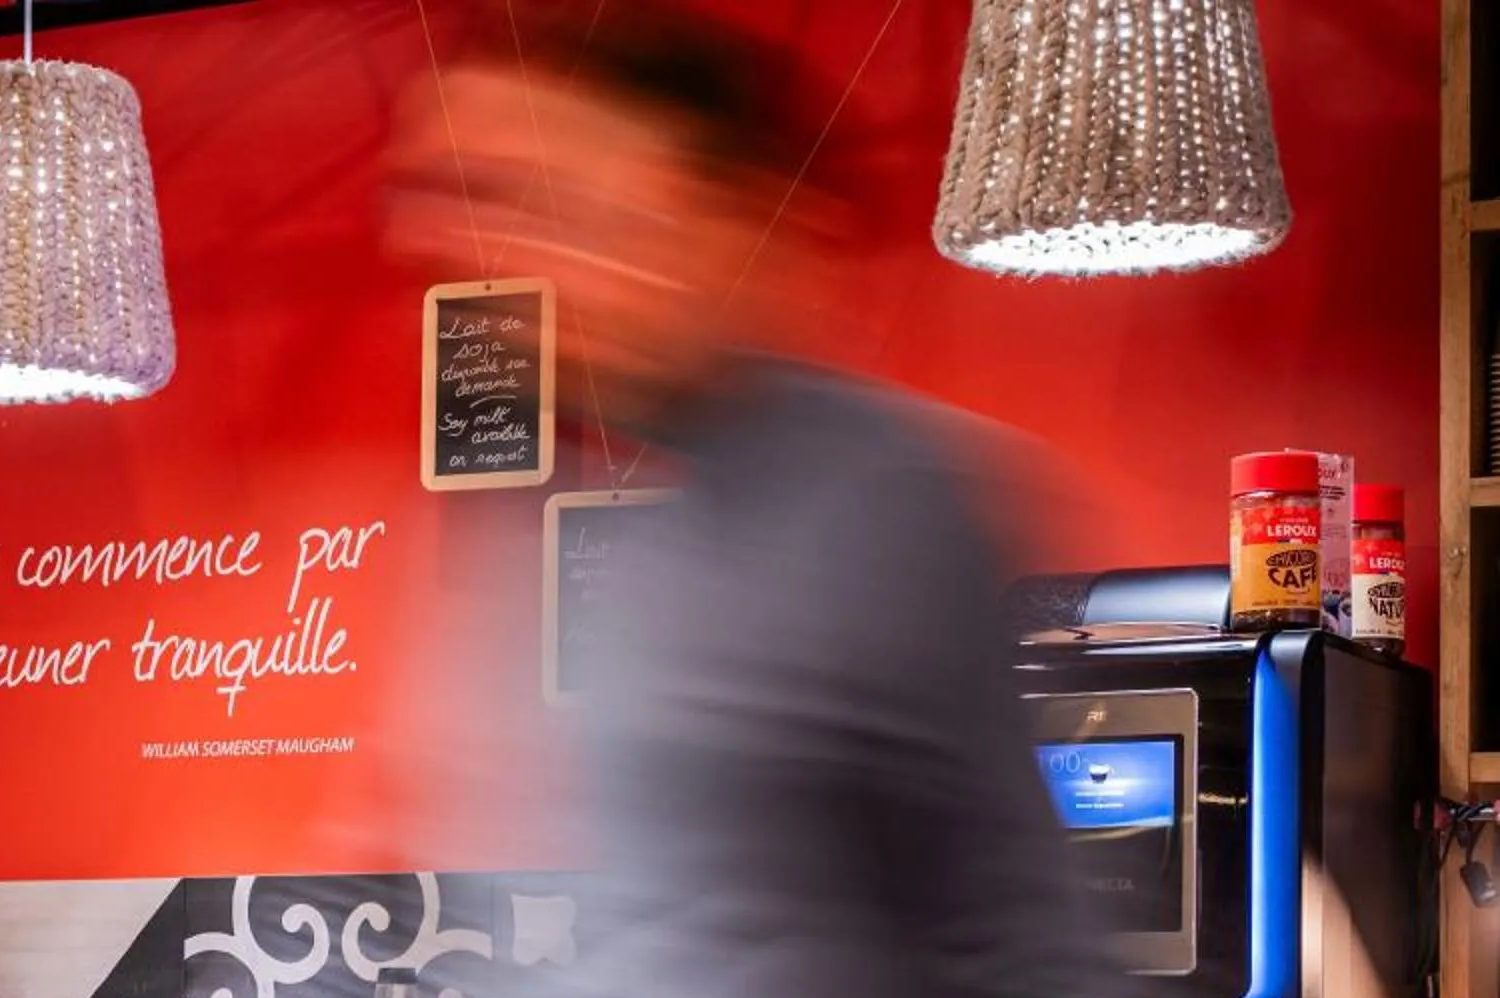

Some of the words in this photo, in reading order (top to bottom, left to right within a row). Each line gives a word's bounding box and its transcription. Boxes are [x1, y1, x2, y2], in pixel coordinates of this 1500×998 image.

[440, 317, 492, 339] Lait
[500, 315, 526, 332] de
[453, 342, 505, 364] soja
[438, 412, 468, 437] Soy
[474, 406, 511, 426] milk
[1267, 525, 1317, 537] LEROUX
[17, 531, 261, 587] commence
[287, 521, 385, 613] par
[1369, 556, 1405, 569] LEROU
[132, 597, 357, 717] tranquille.
[142, 739, 199, 758] WILLIAM
[202, 739, 274, 757] SOMERSET
[277, 736, 354, 754] MAUGHAM
